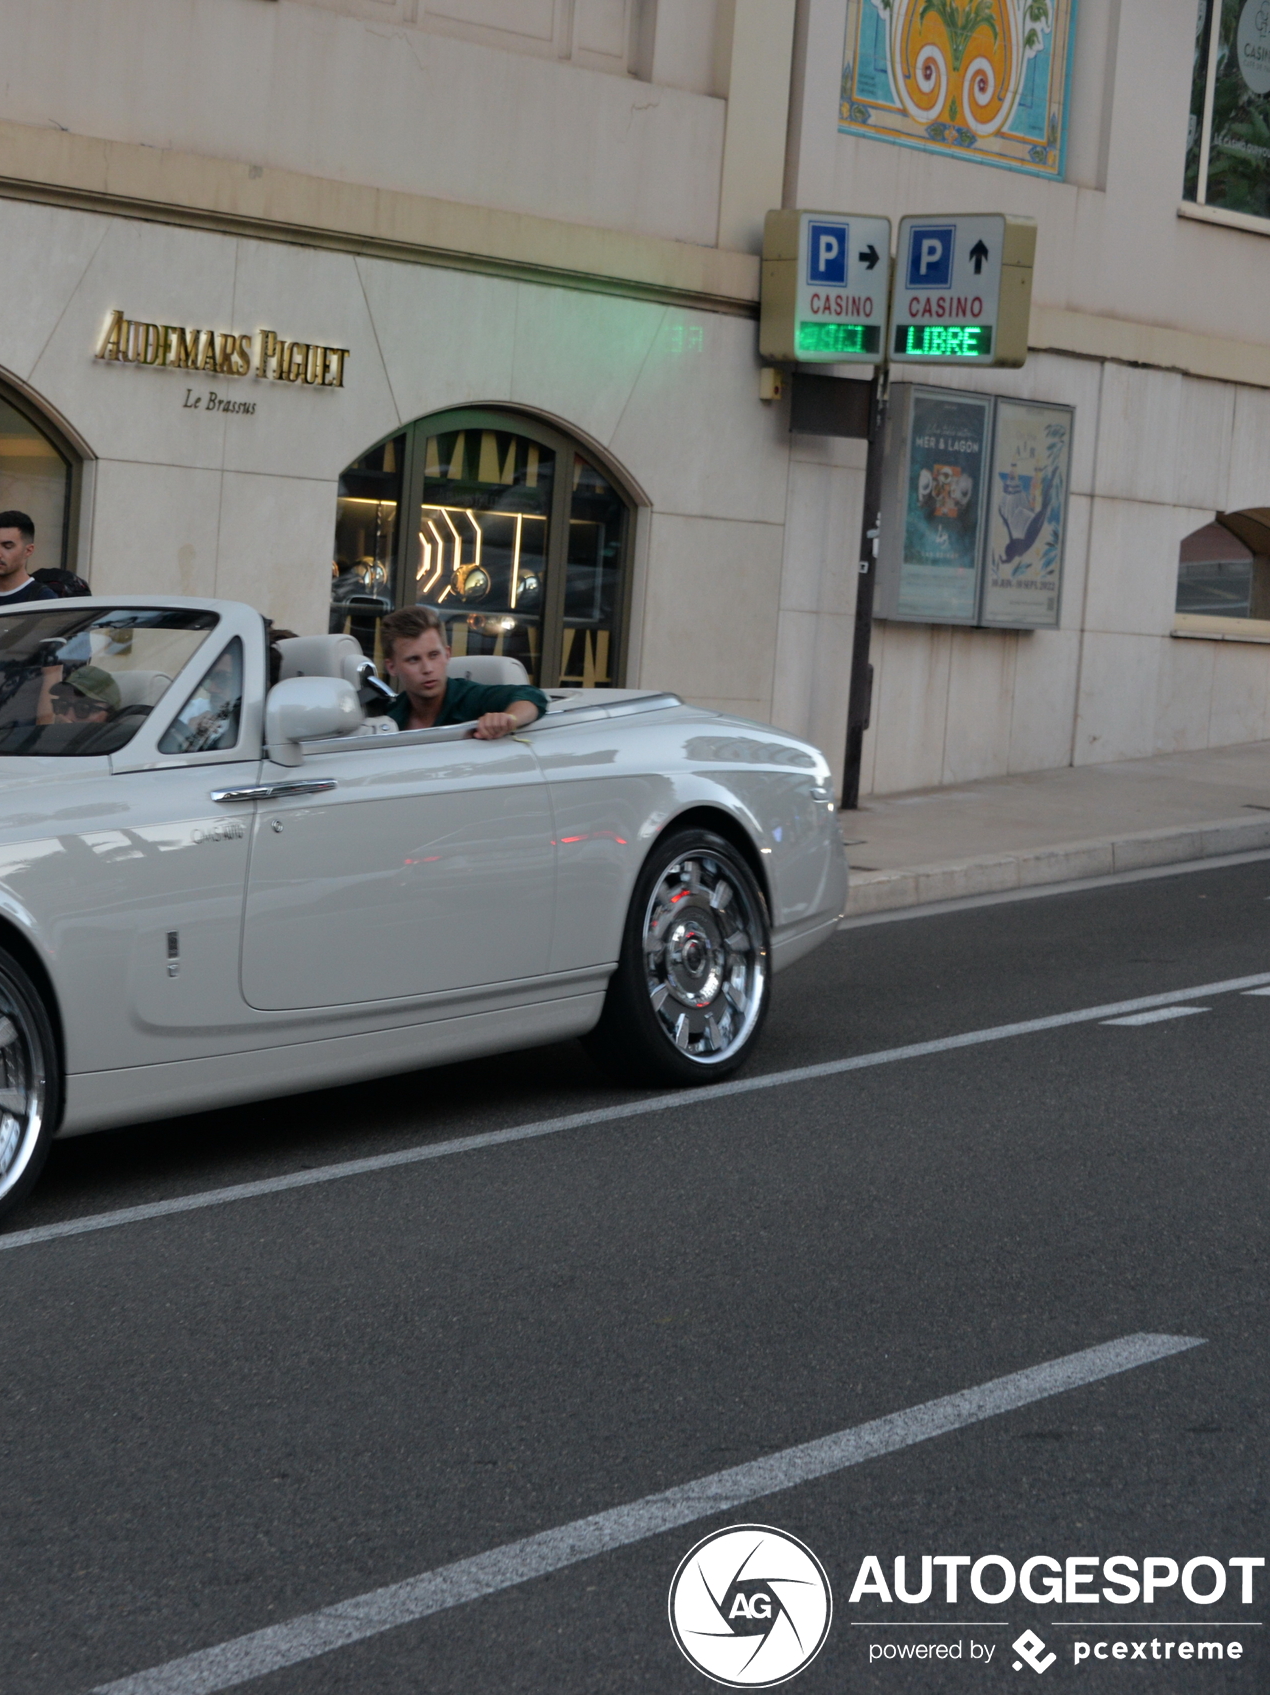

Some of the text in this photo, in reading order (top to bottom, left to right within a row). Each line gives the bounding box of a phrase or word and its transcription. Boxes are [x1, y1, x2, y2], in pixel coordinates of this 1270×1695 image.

[819, 235, 839, 272] P
[920, 238, 943, 275] P
[810, 293, 873, 318] CASINO
[908, 297, 983, 319] CASINO
[95, 309, 350, 388] AUDEMARS PIGUET
[906, 325, 981, 356] LIBRE
[183, 389, 256, 415] Le Brassus
[915, 435, 936, 450] MER
[947, 438, 979, 453] LAGON
